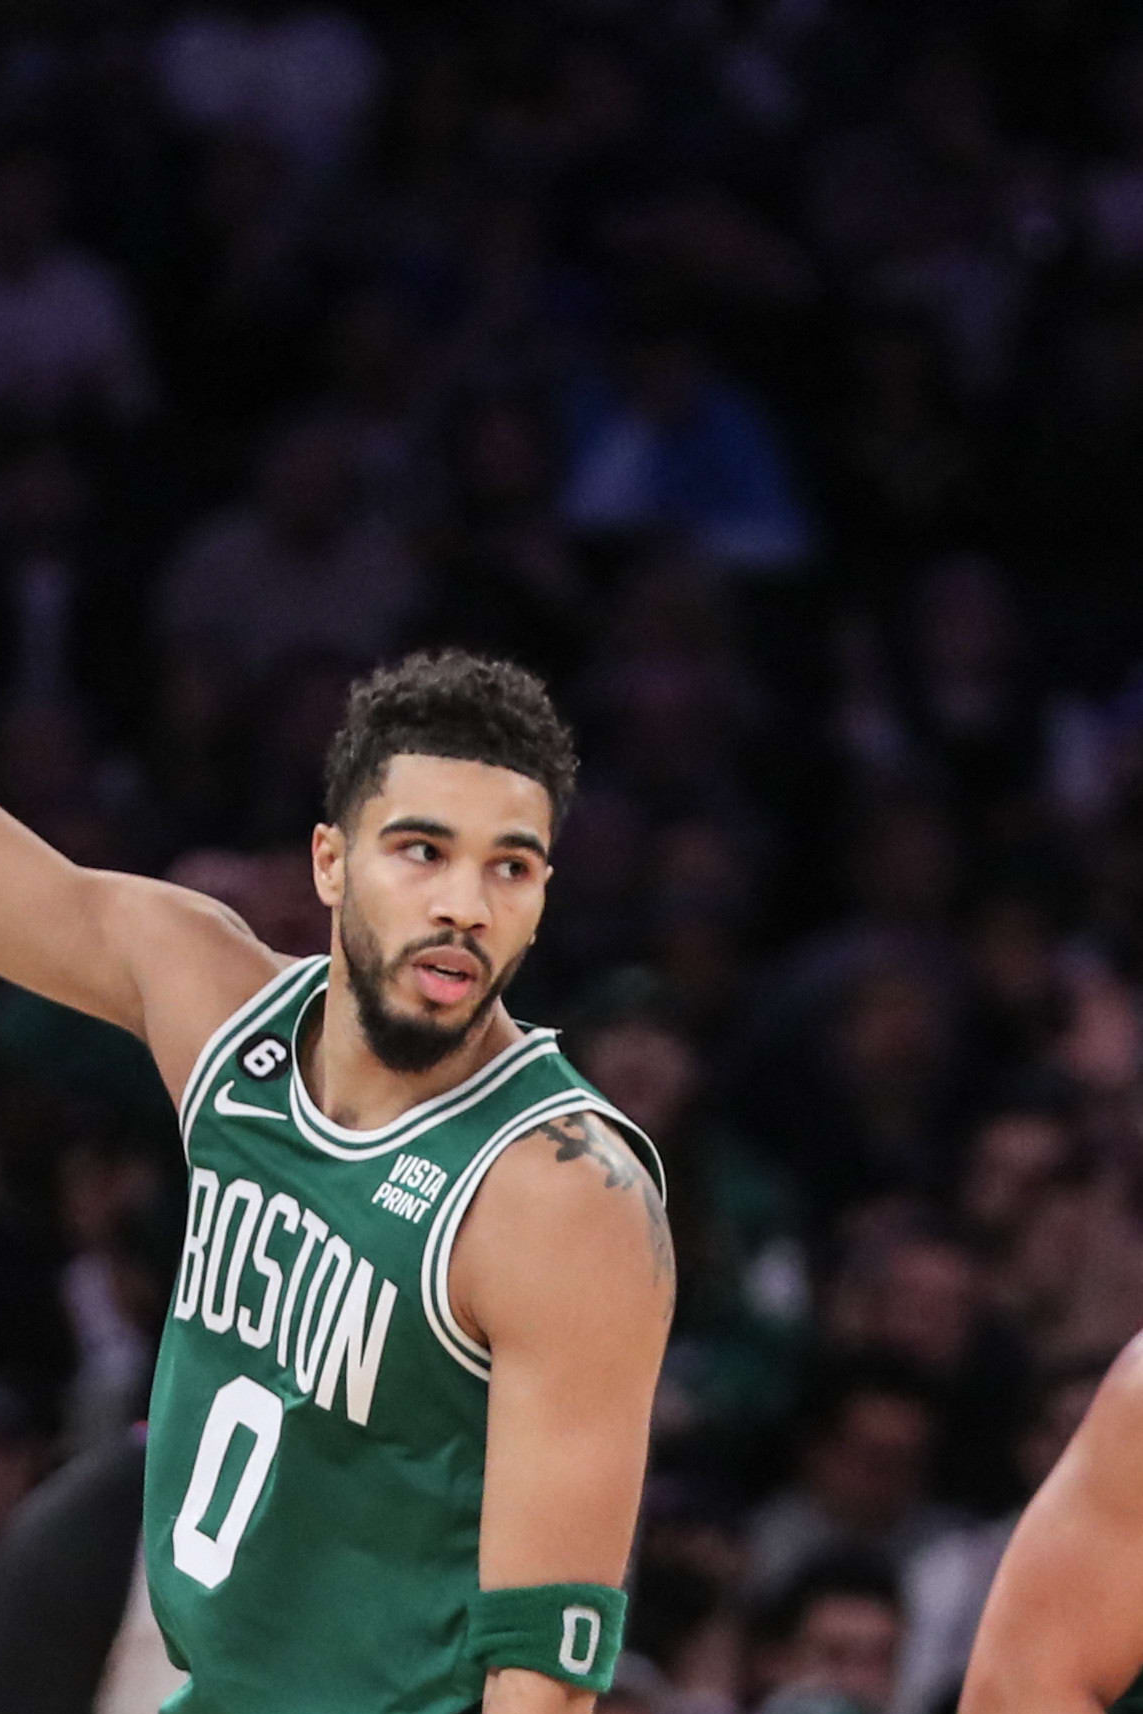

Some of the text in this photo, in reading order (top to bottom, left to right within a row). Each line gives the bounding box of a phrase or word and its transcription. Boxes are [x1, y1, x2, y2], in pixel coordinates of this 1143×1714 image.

[243, 1038, 287, 1077] 6
[371, 1182, 431, 1224] PRINT
[388, 1153, 448, 1203] VISTA
[173, 1168, 399, 1427] BOSTON
[172, 1375, 284, 1590] 0
[560, 1604, 602, 1675] 0
